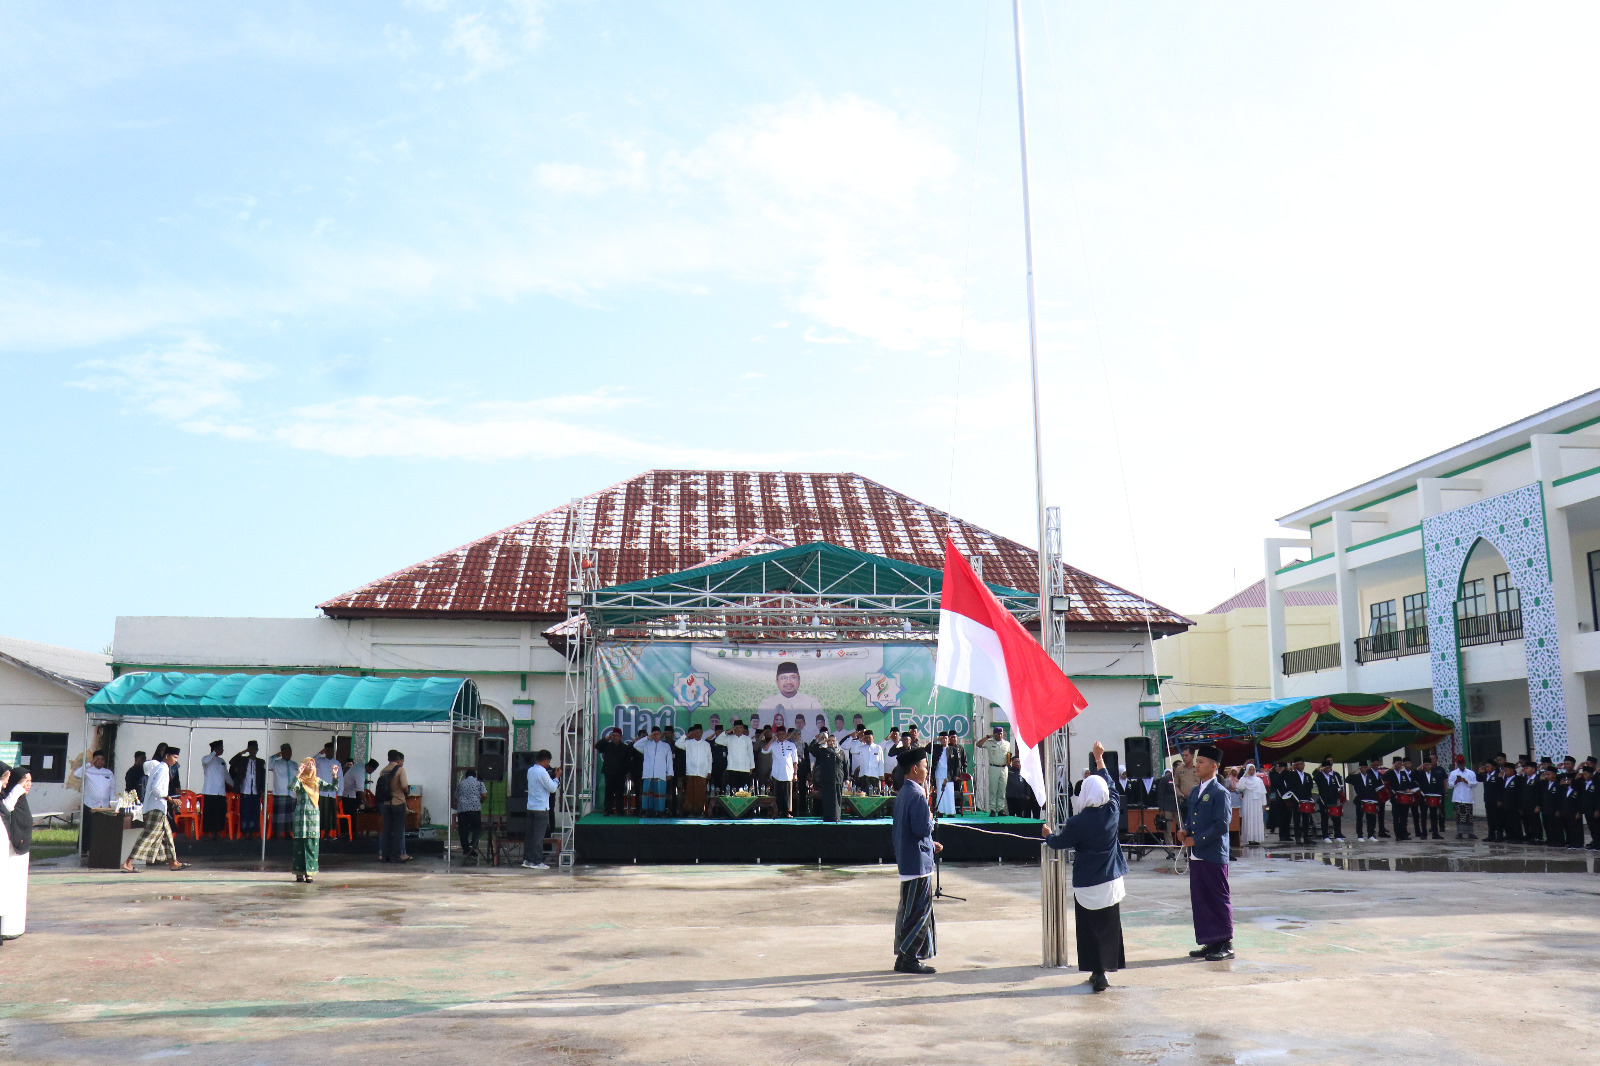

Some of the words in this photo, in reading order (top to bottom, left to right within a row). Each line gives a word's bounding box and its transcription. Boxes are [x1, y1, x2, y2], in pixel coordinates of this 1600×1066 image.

[623, 694, 665, 705] Semarak
[616, 706, 674, 739] Hari
[891, 707, 970, 741] Expo
